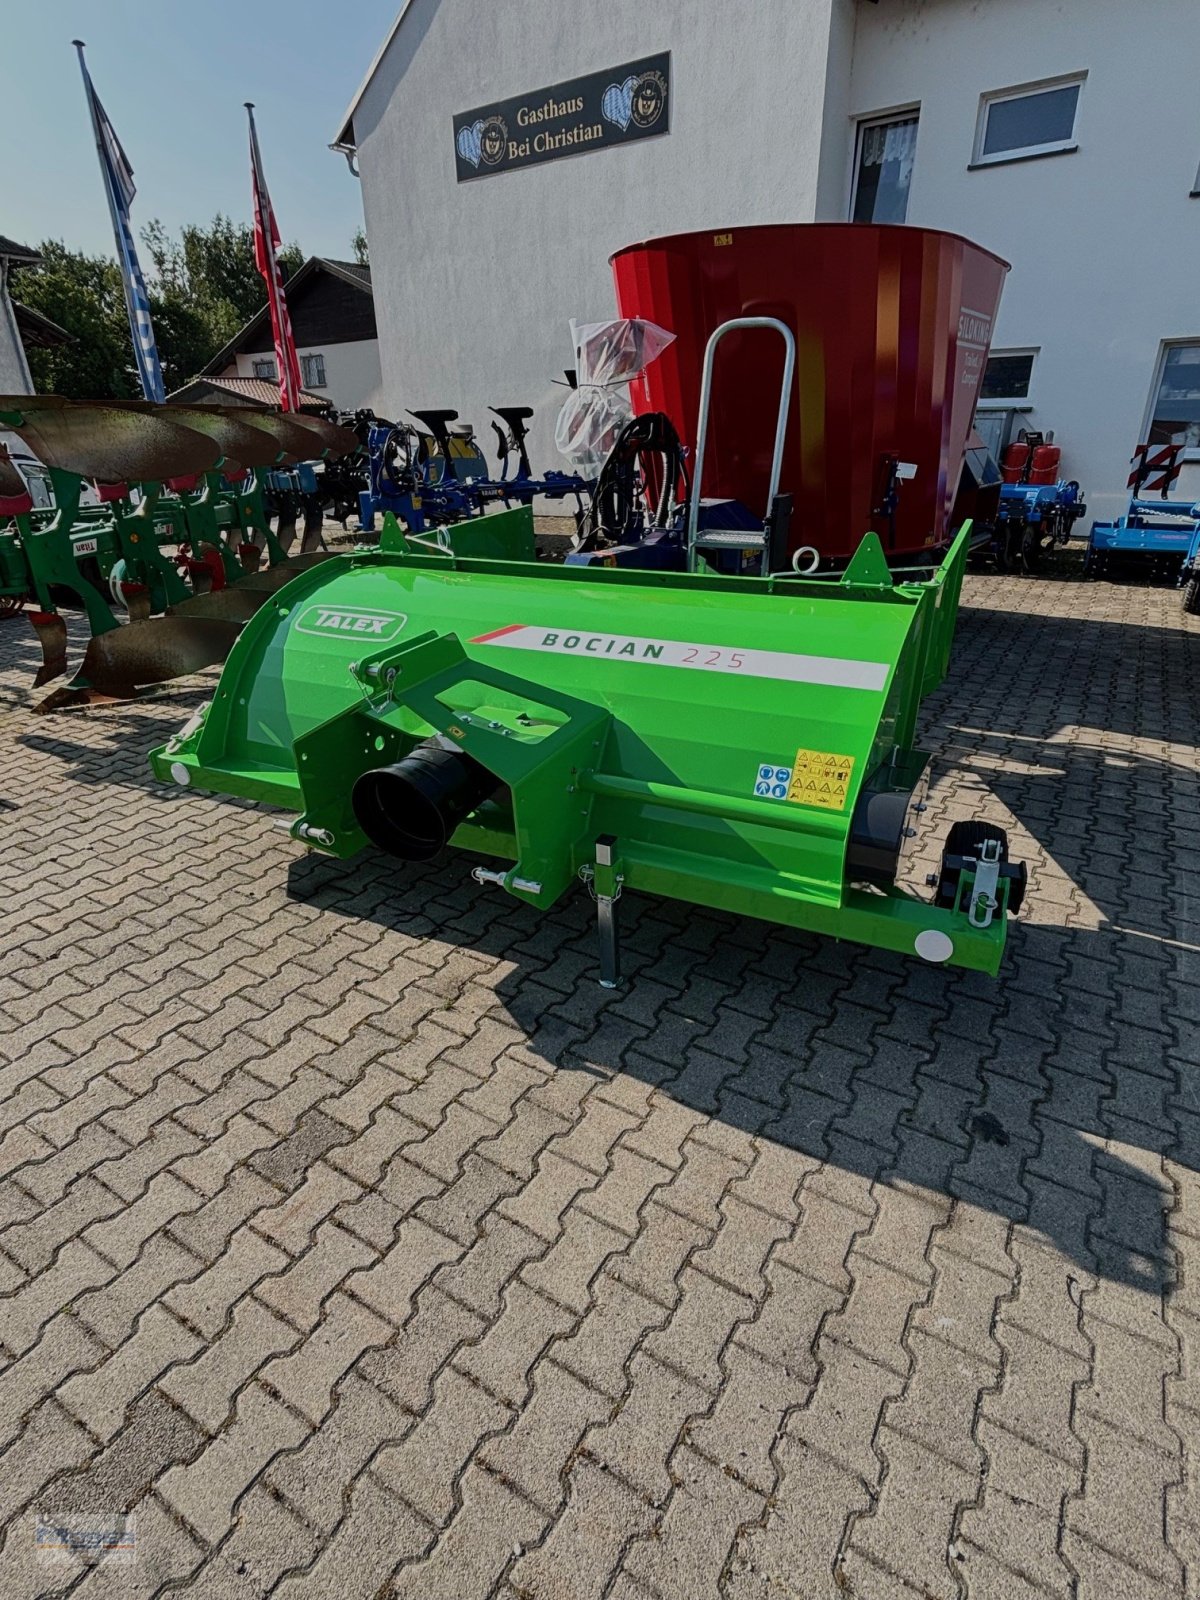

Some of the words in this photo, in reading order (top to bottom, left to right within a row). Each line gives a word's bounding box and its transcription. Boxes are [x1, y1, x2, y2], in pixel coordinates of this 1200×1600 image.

[517, 96, 584, 127] Gasthaus
[508, 141, 530, 160] Bei
[533, 123, 603, 153] Christian
[76, 541, 95, 552] Titan
[314, 609, 396, 634] TALEX
[541, 633, 665, 659] BOCIAN
[682, 648, 746, 669] 225
